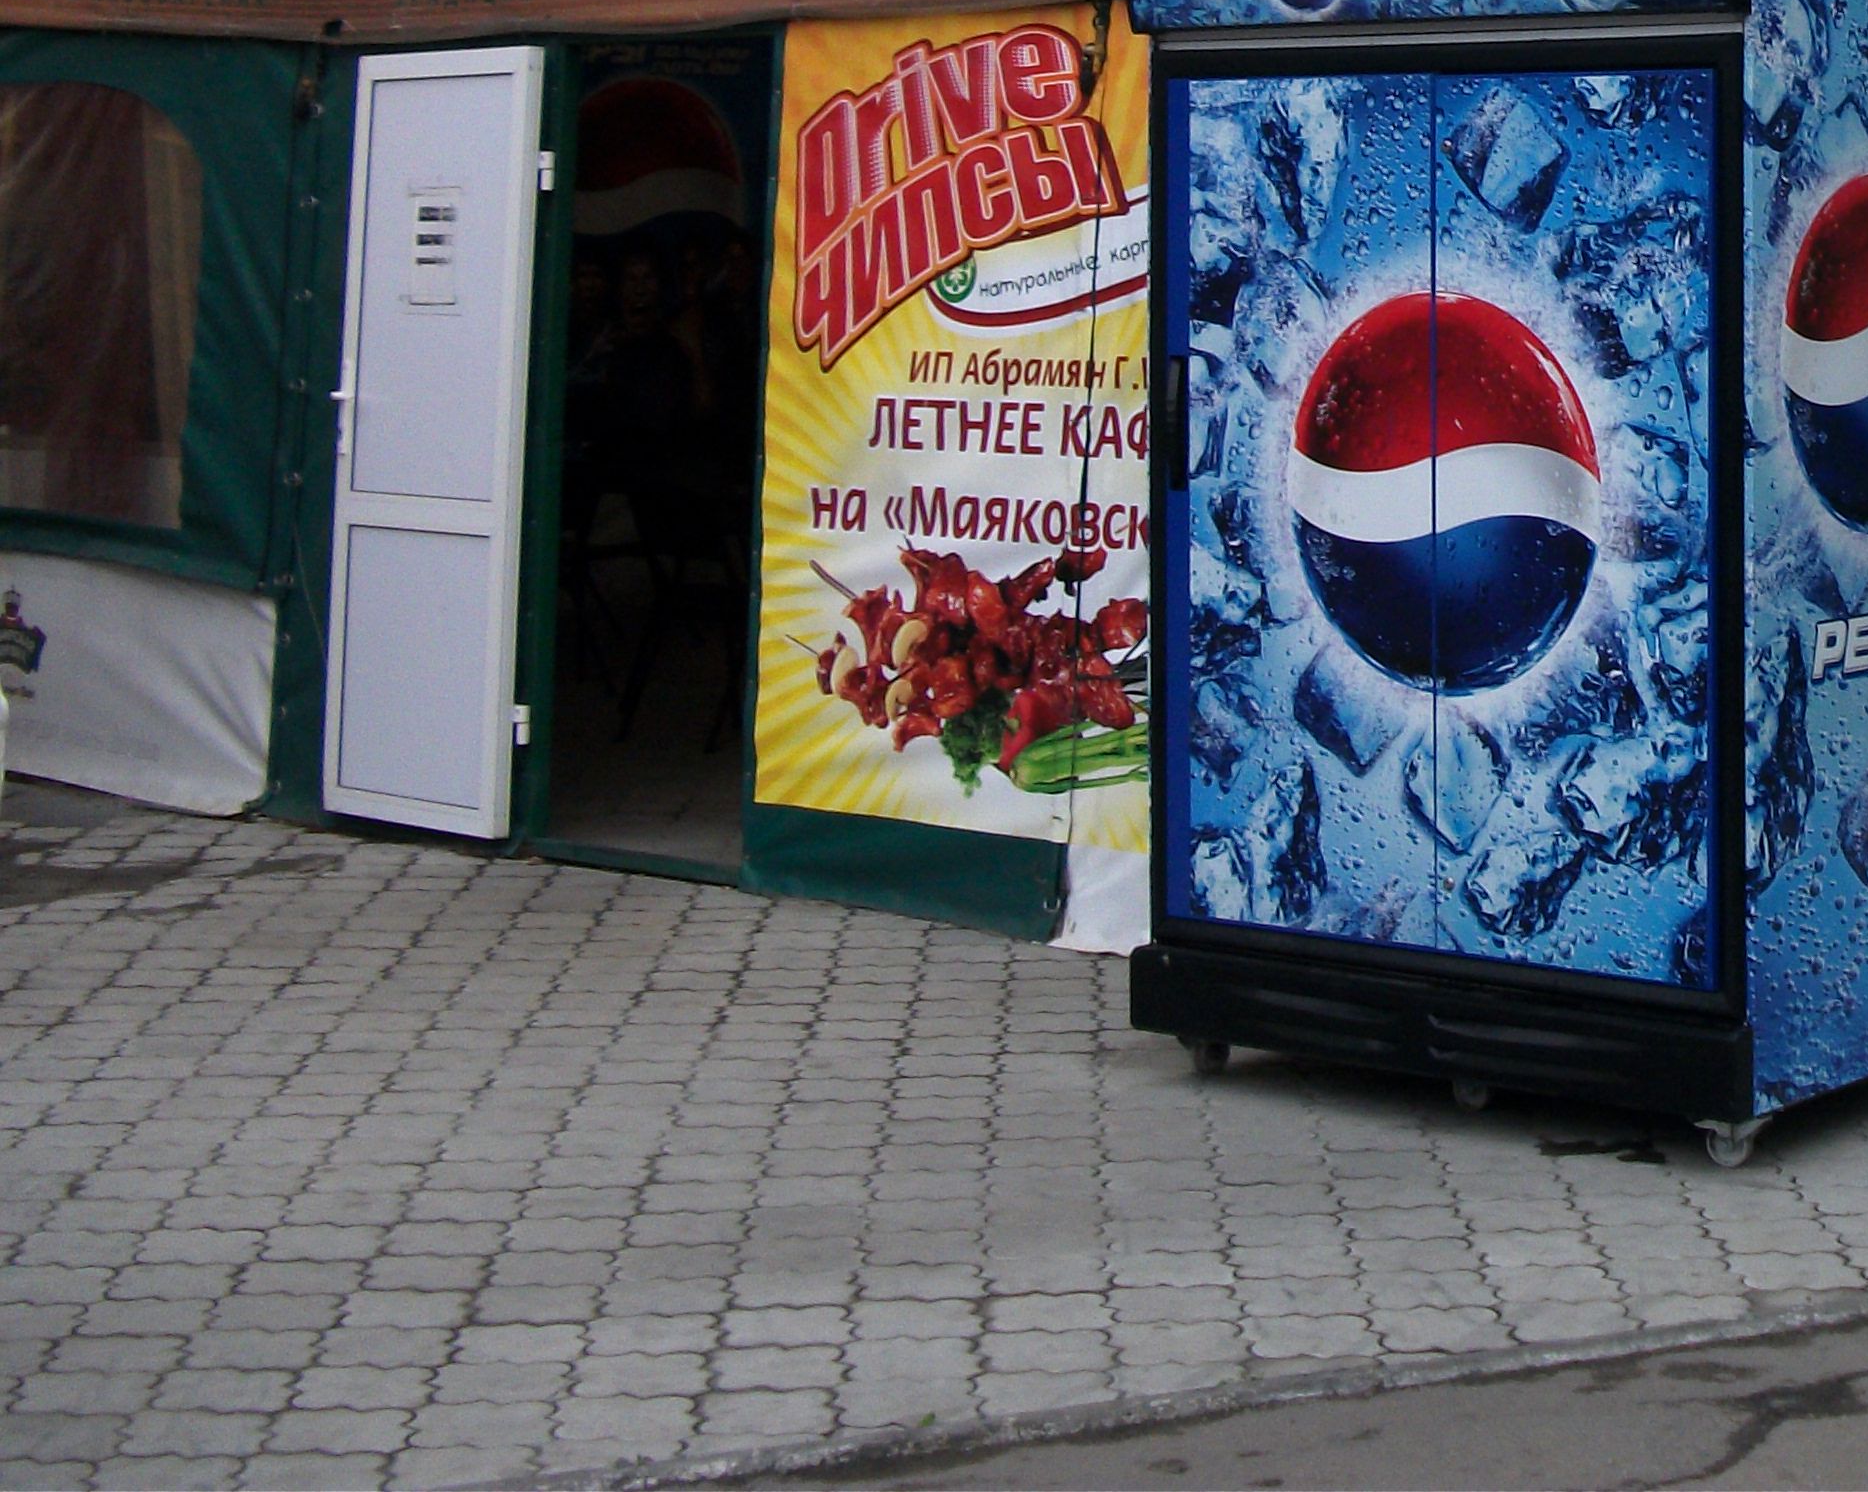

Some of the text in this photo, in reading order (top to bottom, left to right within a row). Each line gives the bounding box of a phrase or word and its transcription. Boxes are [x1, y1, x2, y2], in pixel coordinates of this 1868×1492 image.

[801, 30, 1079, 264] Drive
[979, 255, 1101, 298] натуральные
[909, 350, 953, 384] ИП
[961, 348, 1107, 396] Абрамян
[869, 397, 1045, 455] ЛЕТНЕЕ
[811, 487, 868, 533] на
